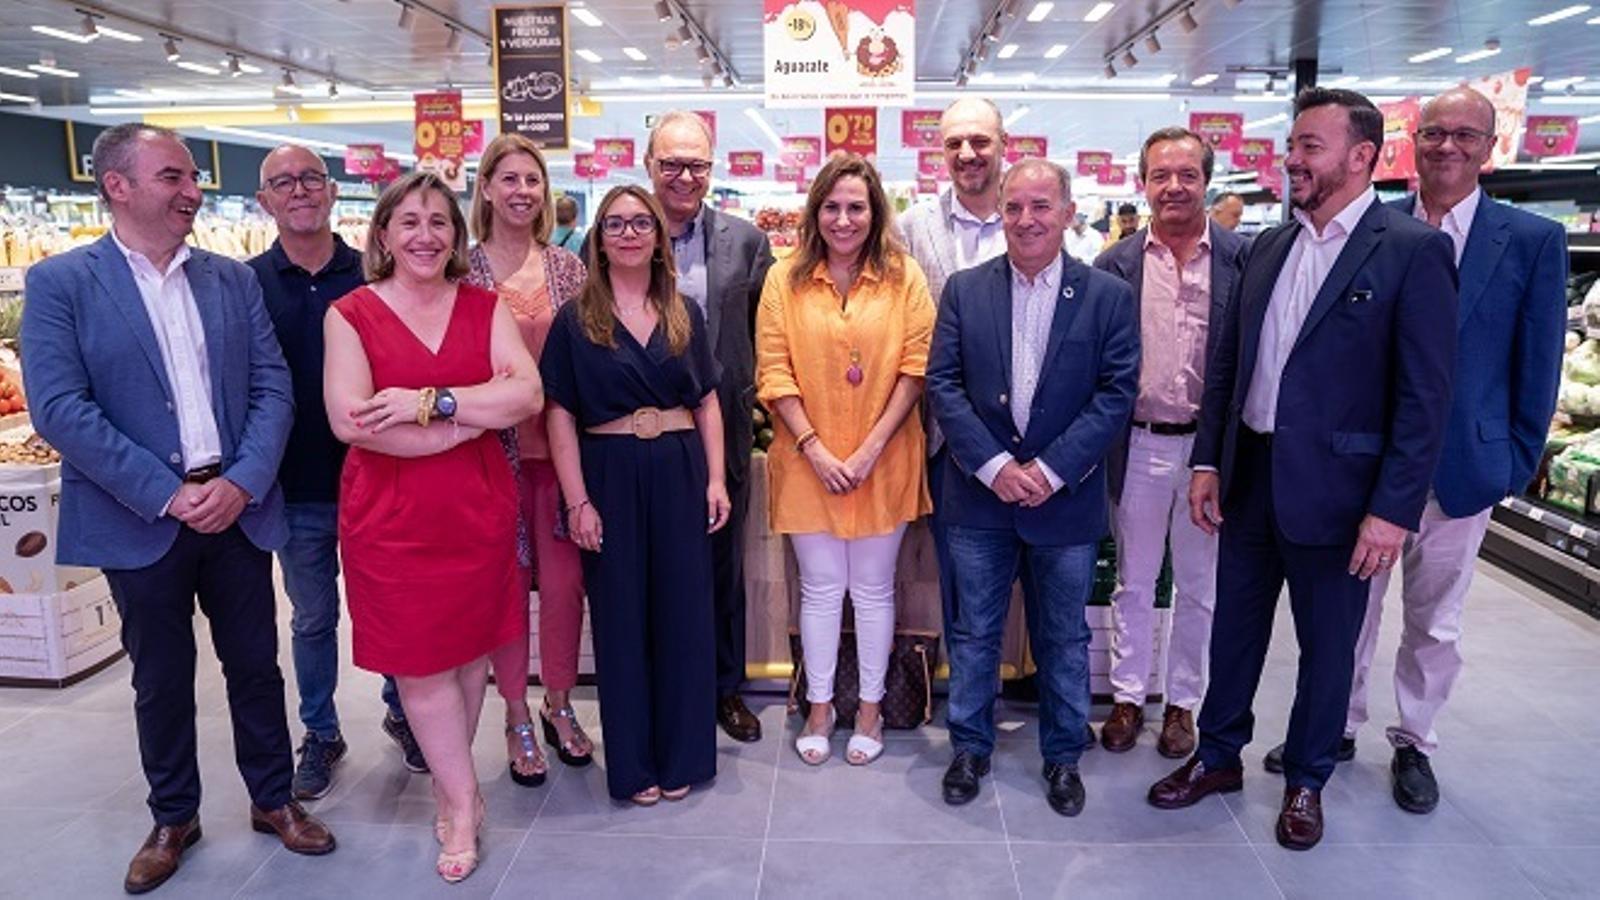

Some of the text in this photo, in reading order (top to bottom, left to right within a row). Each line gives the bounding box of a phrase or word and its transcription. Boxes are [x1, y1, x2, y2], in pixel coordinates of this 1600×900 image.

[503, 15, 557, 27] NUESTRAS
[511, 27, 550, 37] FRUTAS
[507, 37, 562, 48] VERDURAS
[774, 59, 830, 75] Aguacate
